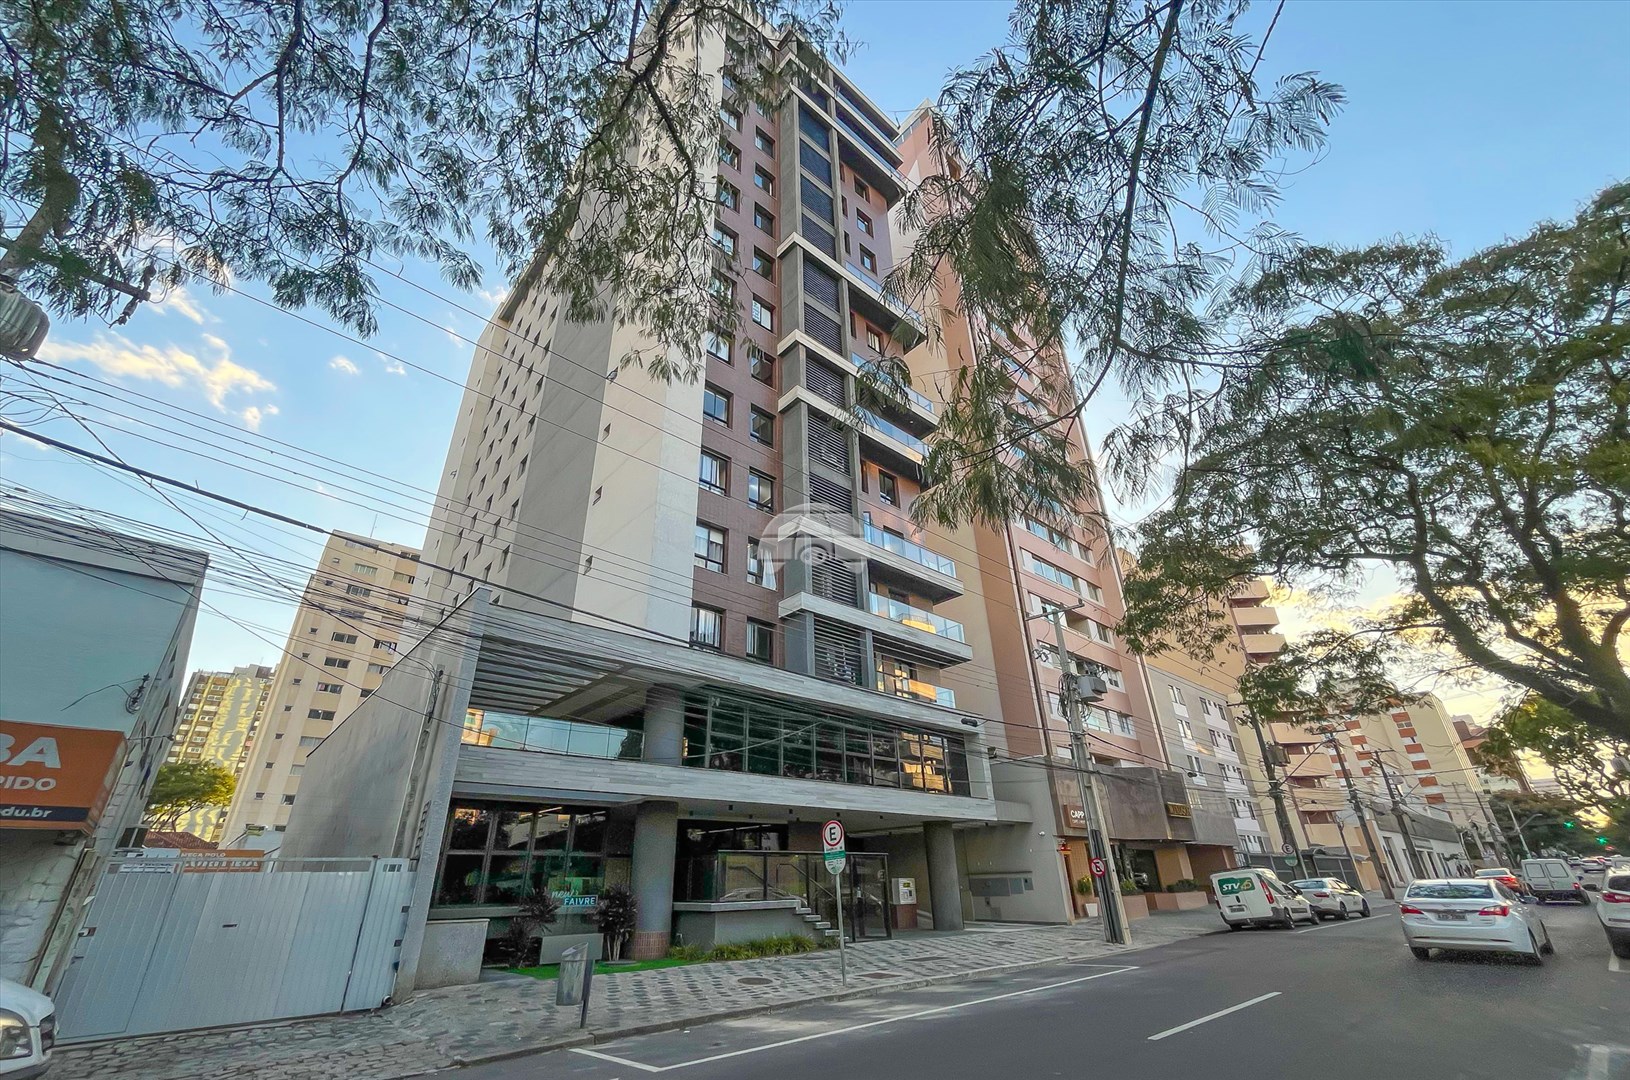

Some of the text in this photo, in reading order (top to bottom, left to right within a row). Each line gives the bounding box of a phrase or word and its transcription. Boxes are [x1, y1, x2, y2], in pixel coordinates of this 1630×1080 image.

[0, 775, 57, 791] IDO
[0, 806, 52, 818] du.br
[829, 826, 837, 841] E
[1222, 882, 1240, 891] STV
[564, 897, 596, 905] FAIVRE
